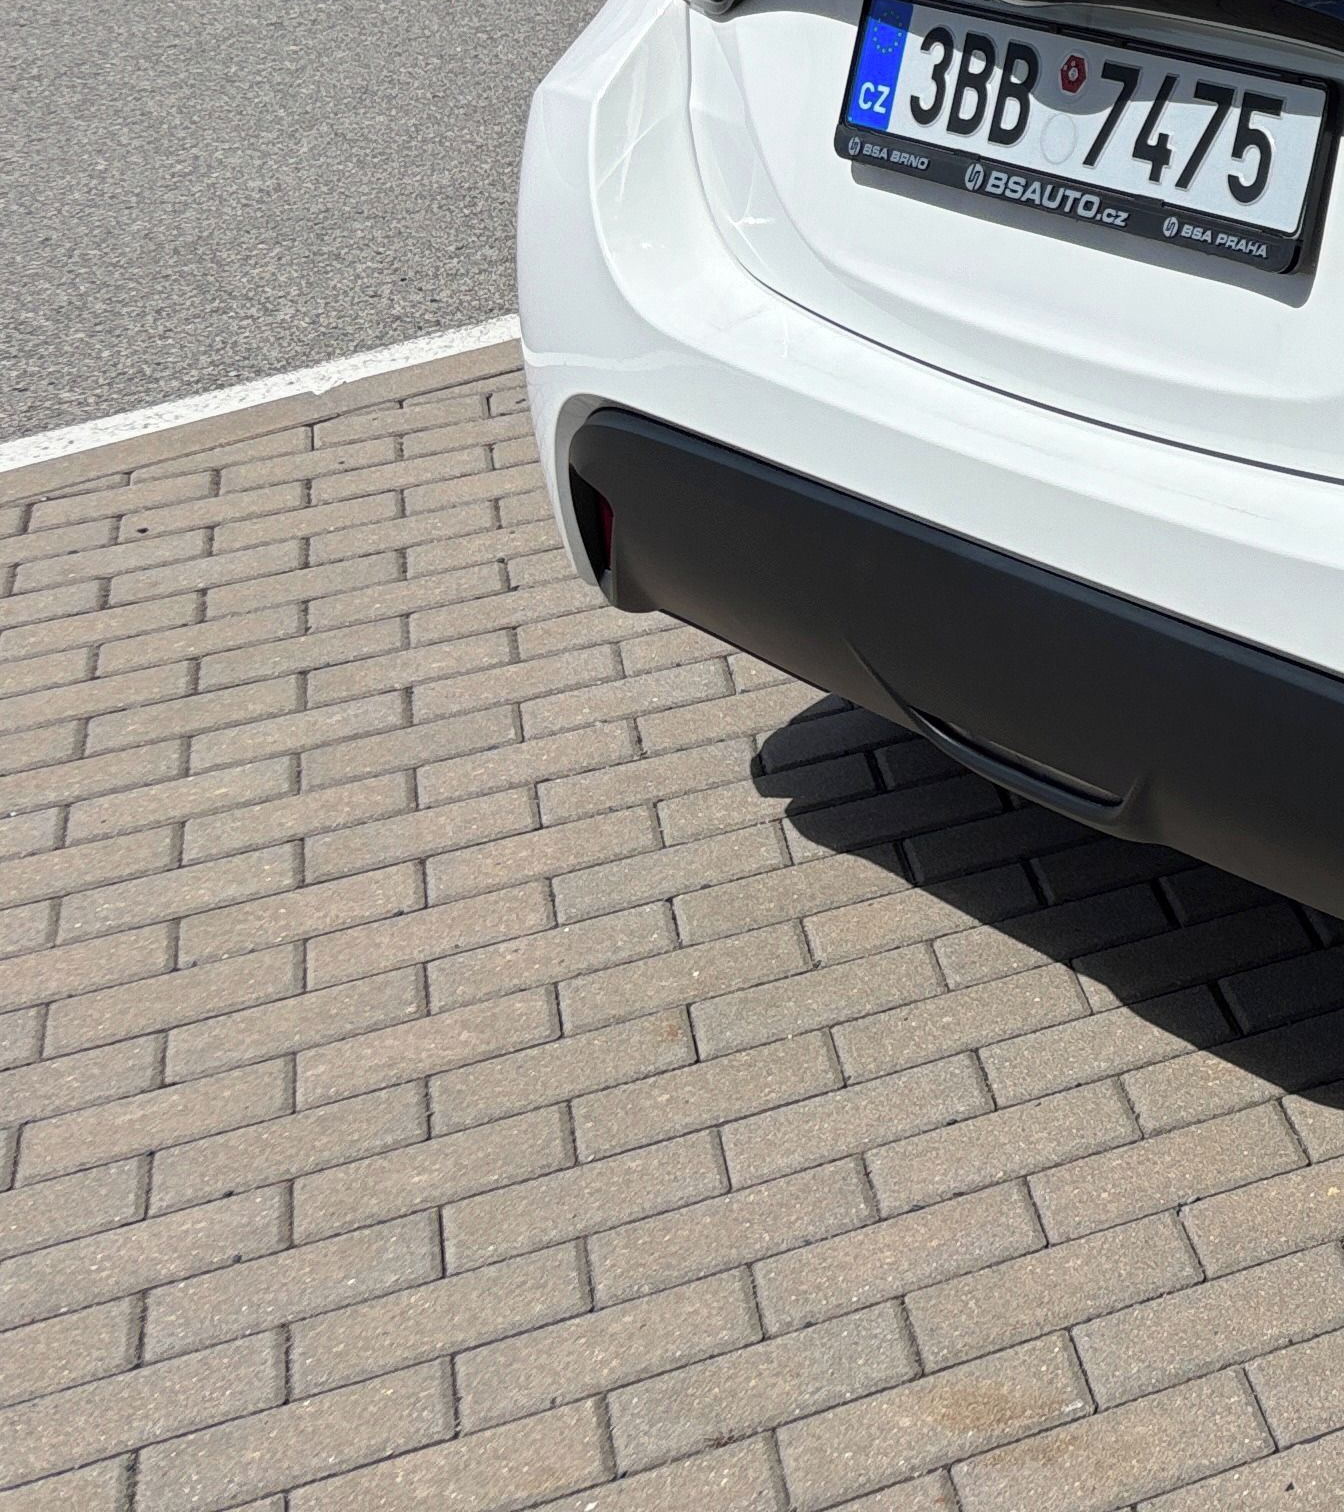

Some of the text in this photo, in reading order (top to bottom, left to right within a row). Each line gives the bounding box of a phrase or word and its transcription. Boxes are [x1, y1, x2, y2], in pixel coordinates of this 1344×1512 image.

[857, 26, 1286, 205] CZ 3BB 7475
[862, 143, 930, 171] BSA BRNO
[1180, 222, 1269, 259] BSA PRAHA
